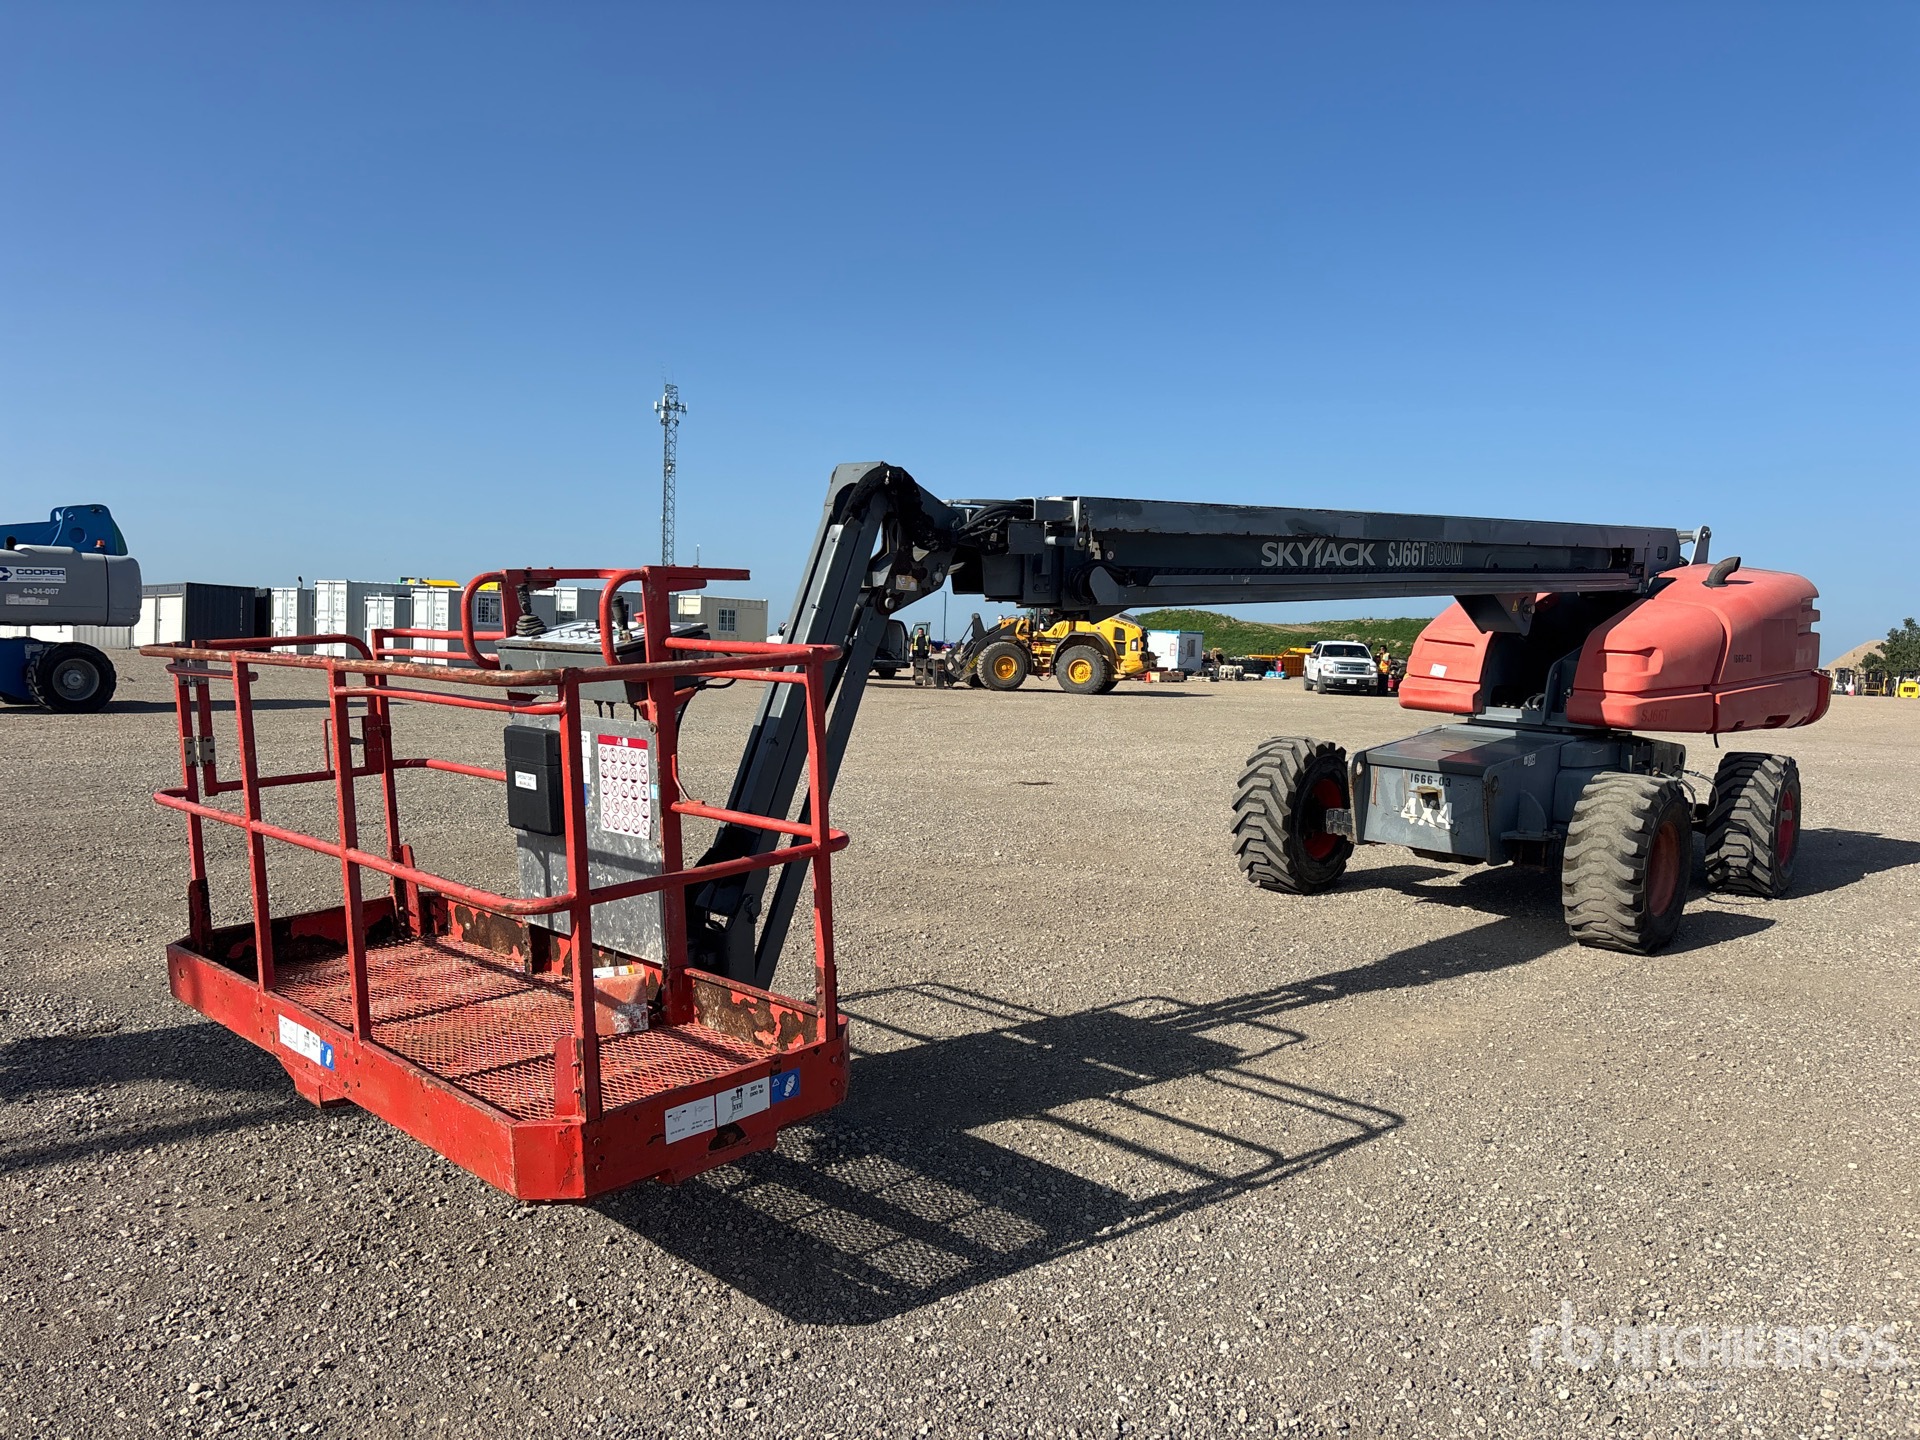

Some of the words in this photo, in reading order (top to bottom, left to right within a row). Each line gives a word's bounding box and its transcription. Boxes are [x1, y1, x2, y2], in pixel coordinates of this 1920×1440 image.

[1261, 538, 1375, 568] SKYJACK
[16, 568, 65, 576] COOPER
[22, 587, 60, 595] 4434-007
[1410, 772, 1452, 788] 1666-03
